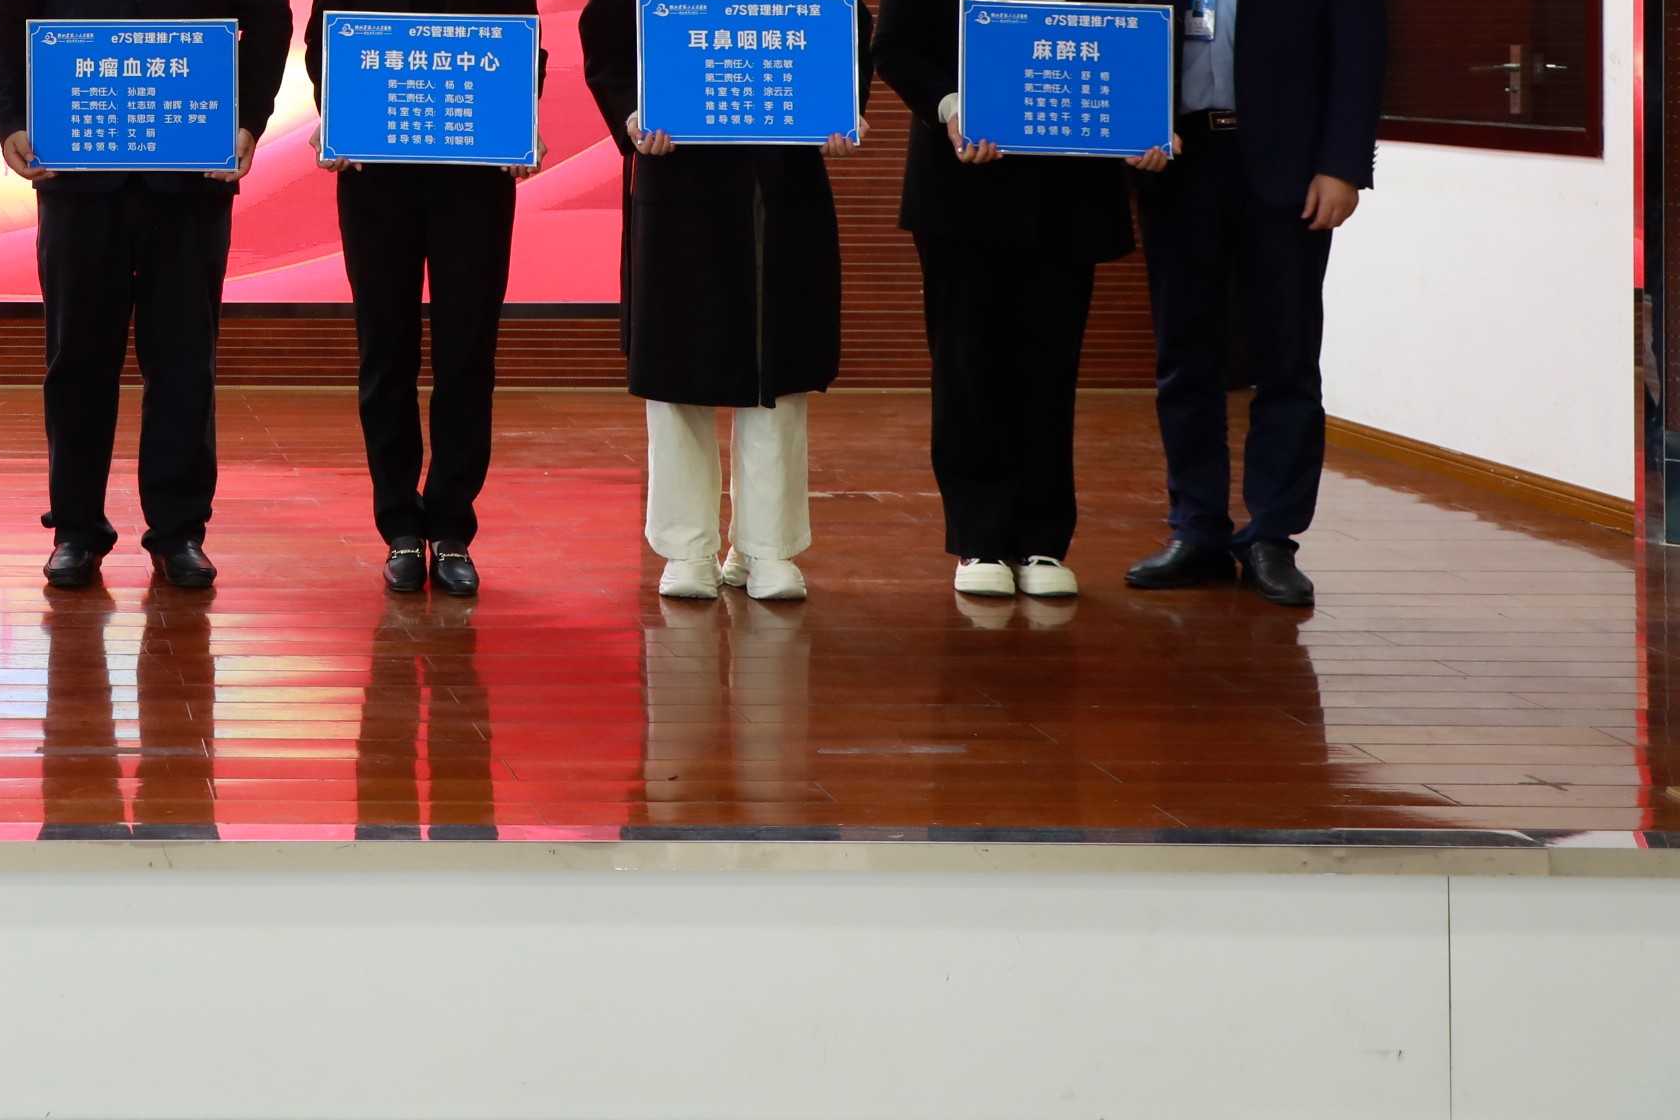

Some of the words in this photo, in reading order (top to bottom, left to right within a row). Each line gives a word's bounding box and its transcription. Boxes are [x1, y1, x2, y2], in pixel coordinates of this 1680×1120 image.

[725, 4, 821, 16] e7S管理推广科室
[1045, 15, 1138, 29] e7S管理推广科室
[112, 32, 203, 44] e7S管理推广科室
[409, 26, 502, 38] e7S管理推广科室
[688, 30, 807, 50] 耳鼻咽喉科
[1033, 40, 1100, 62] 麻醉科
[361, 50, 500, 72] 消毒供应中心
[75, 58, 189, 78] 肿瘤血液科
[127, 87, 156, 96] 孙建海
[764, 102, 793, 111] 李阳
[164, 115, 182, 124] 王欢
[764, 115, 794, 125] 方亮
